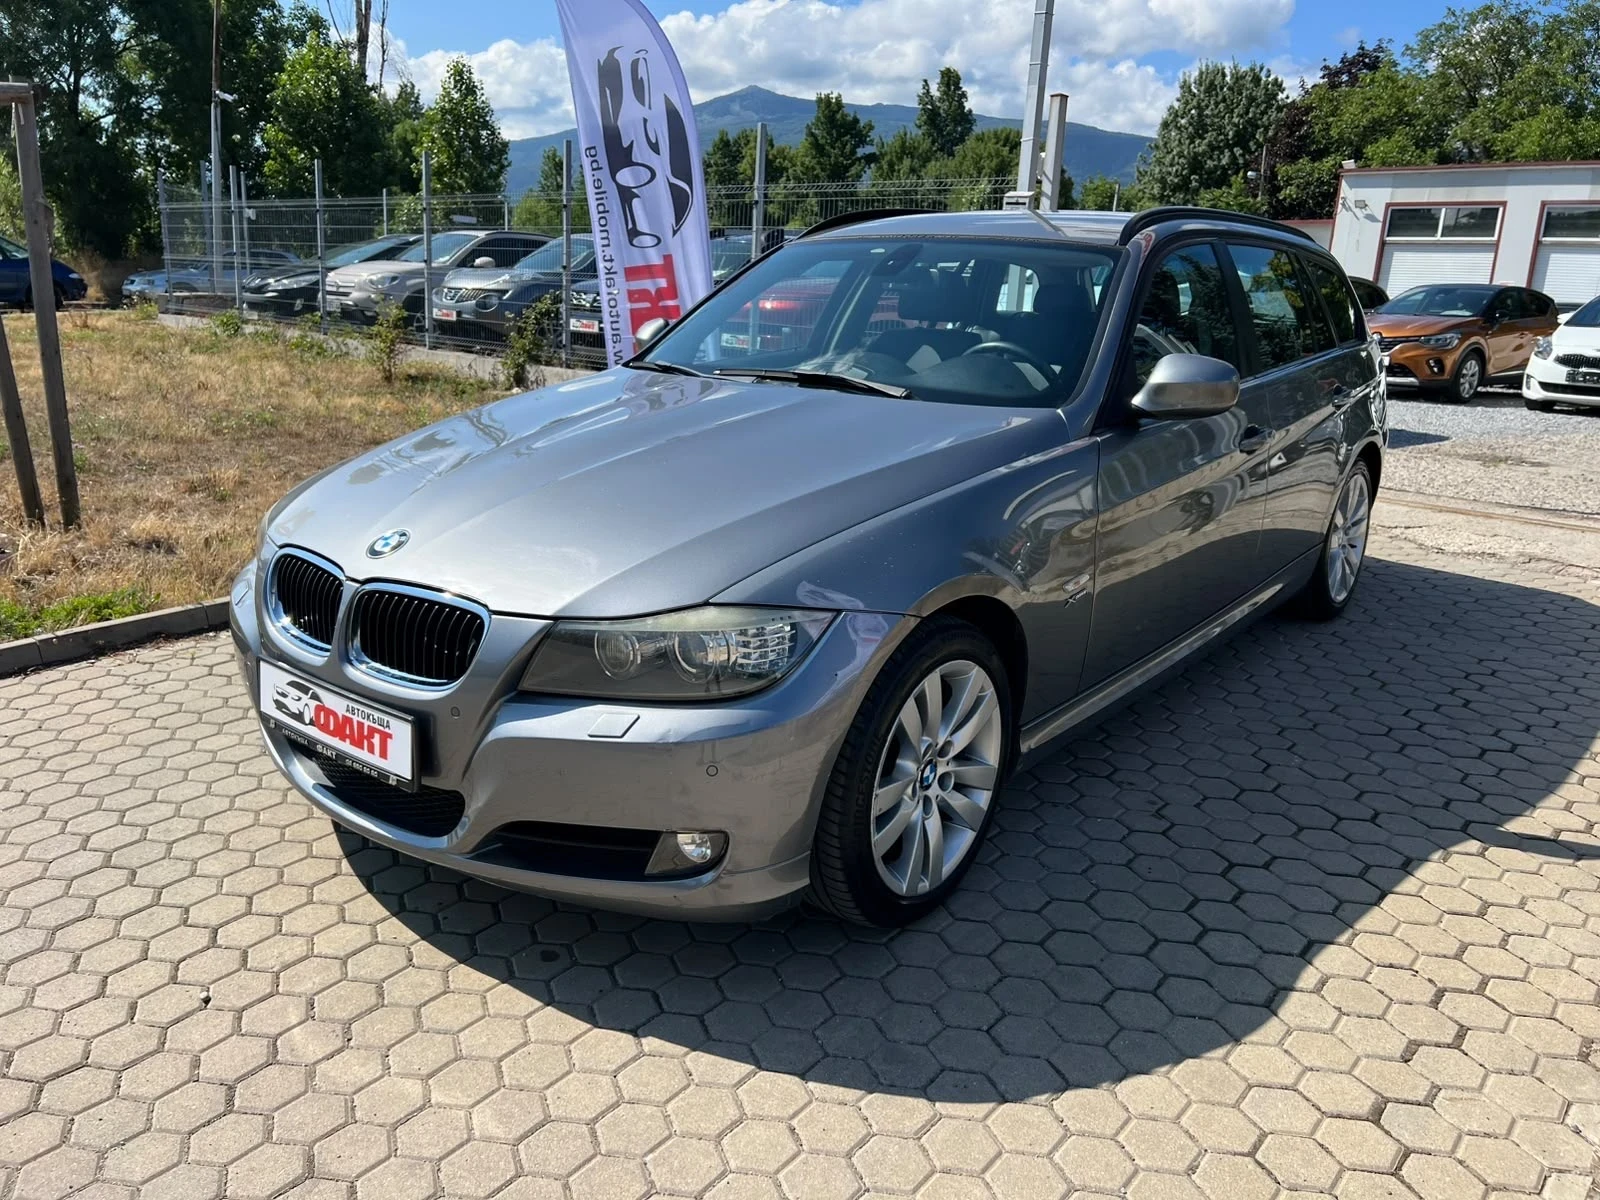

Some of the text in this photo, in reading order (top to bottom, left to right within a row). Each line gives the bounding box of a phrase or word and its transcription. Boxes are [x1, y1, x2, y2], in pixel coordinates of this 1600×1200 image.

[345, 704, 391, 731] АВТОКЪЩА
[313, 704, 393, 760] ФАКТ
[316, 743, 337, 760] ФАКТ
